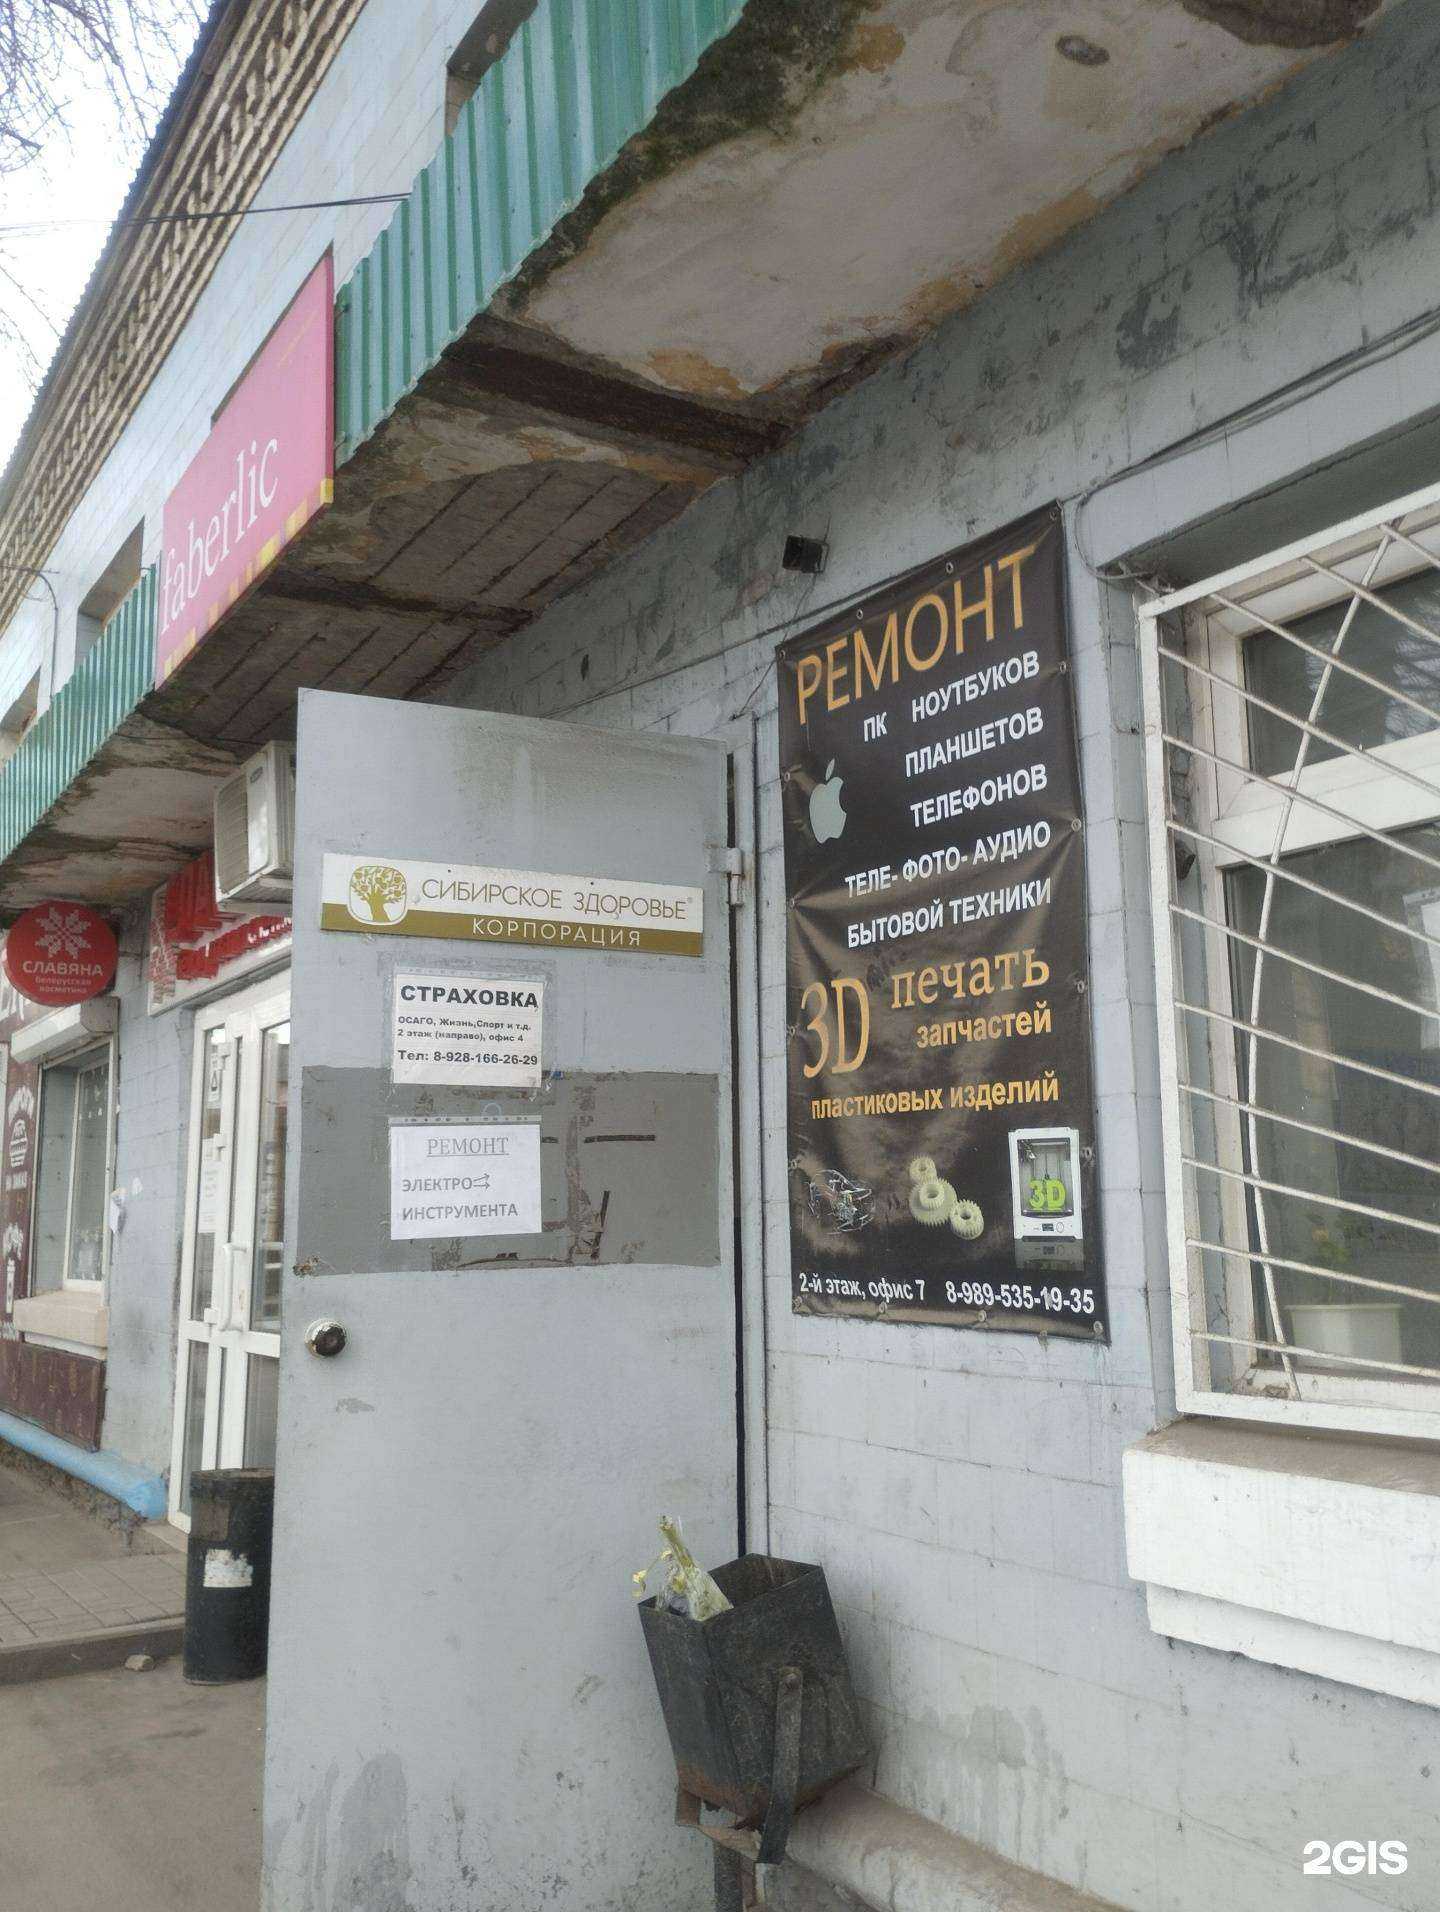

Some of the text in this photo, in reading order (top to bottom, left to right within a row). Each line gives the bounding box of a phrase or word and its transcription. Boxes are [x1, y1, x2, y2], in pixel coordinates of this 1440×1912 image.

[161, 437, 279, 635] faberlic
[796, 544, 1037, 726] РЕМОНТ
[863, 650, 1041, 743] ПК НОУТБУКОВ
[904, 706, 1044, 778] ПЛАНШЕТОВ
[910, 763, 1048, 829] ТЕЛЕФОНОВ
[844, 820, 1051, 898] ТЕЛЕ- ФОТО- АУДИО
[421, 878, 688, 921] СИБИРСКОЕ ЗДОРОВЬЕ
[847, 877, 1051, 949] БЫТОВОЙ ТЕХНИКИ
[472, 917, 642, 947] КОРПОРАЦИЯ
[22, 960, 104, 976] СЛАВЯНА
[890, 948, 1051, 1009] печать
[400, 984, 538, 1008] СТРАХОВКА
[397, 1028, 404, 1037] 2
[406, 1030, 432, 1038] этаж
[488, 1033, 515, 1043] офис
[517, 1034, 524, 1042] 4
[398, 1015, 437, 1027] ОСАГО,
[800, 976, 871, 1078] 3D
[916, 1000, 1052, 1049] запчастей
[397, 1050, 538, 1066] Тел: 8-928-166-26-29
[811, 1070, 1060, 1120] пластиковых изделий
[426, 1136, 509, 1156] РЕМОНТ
[401, 1175, 473, 1193] ЭЛЕКТРО
[1028, 1178, 1068, 1212] 3D
[402, 1202, 519, 1221] ИНСТРУМЕНТА
[799, 1272, 1095, 1314] 2-й этаж, офис 7 8-989-535-19-35
